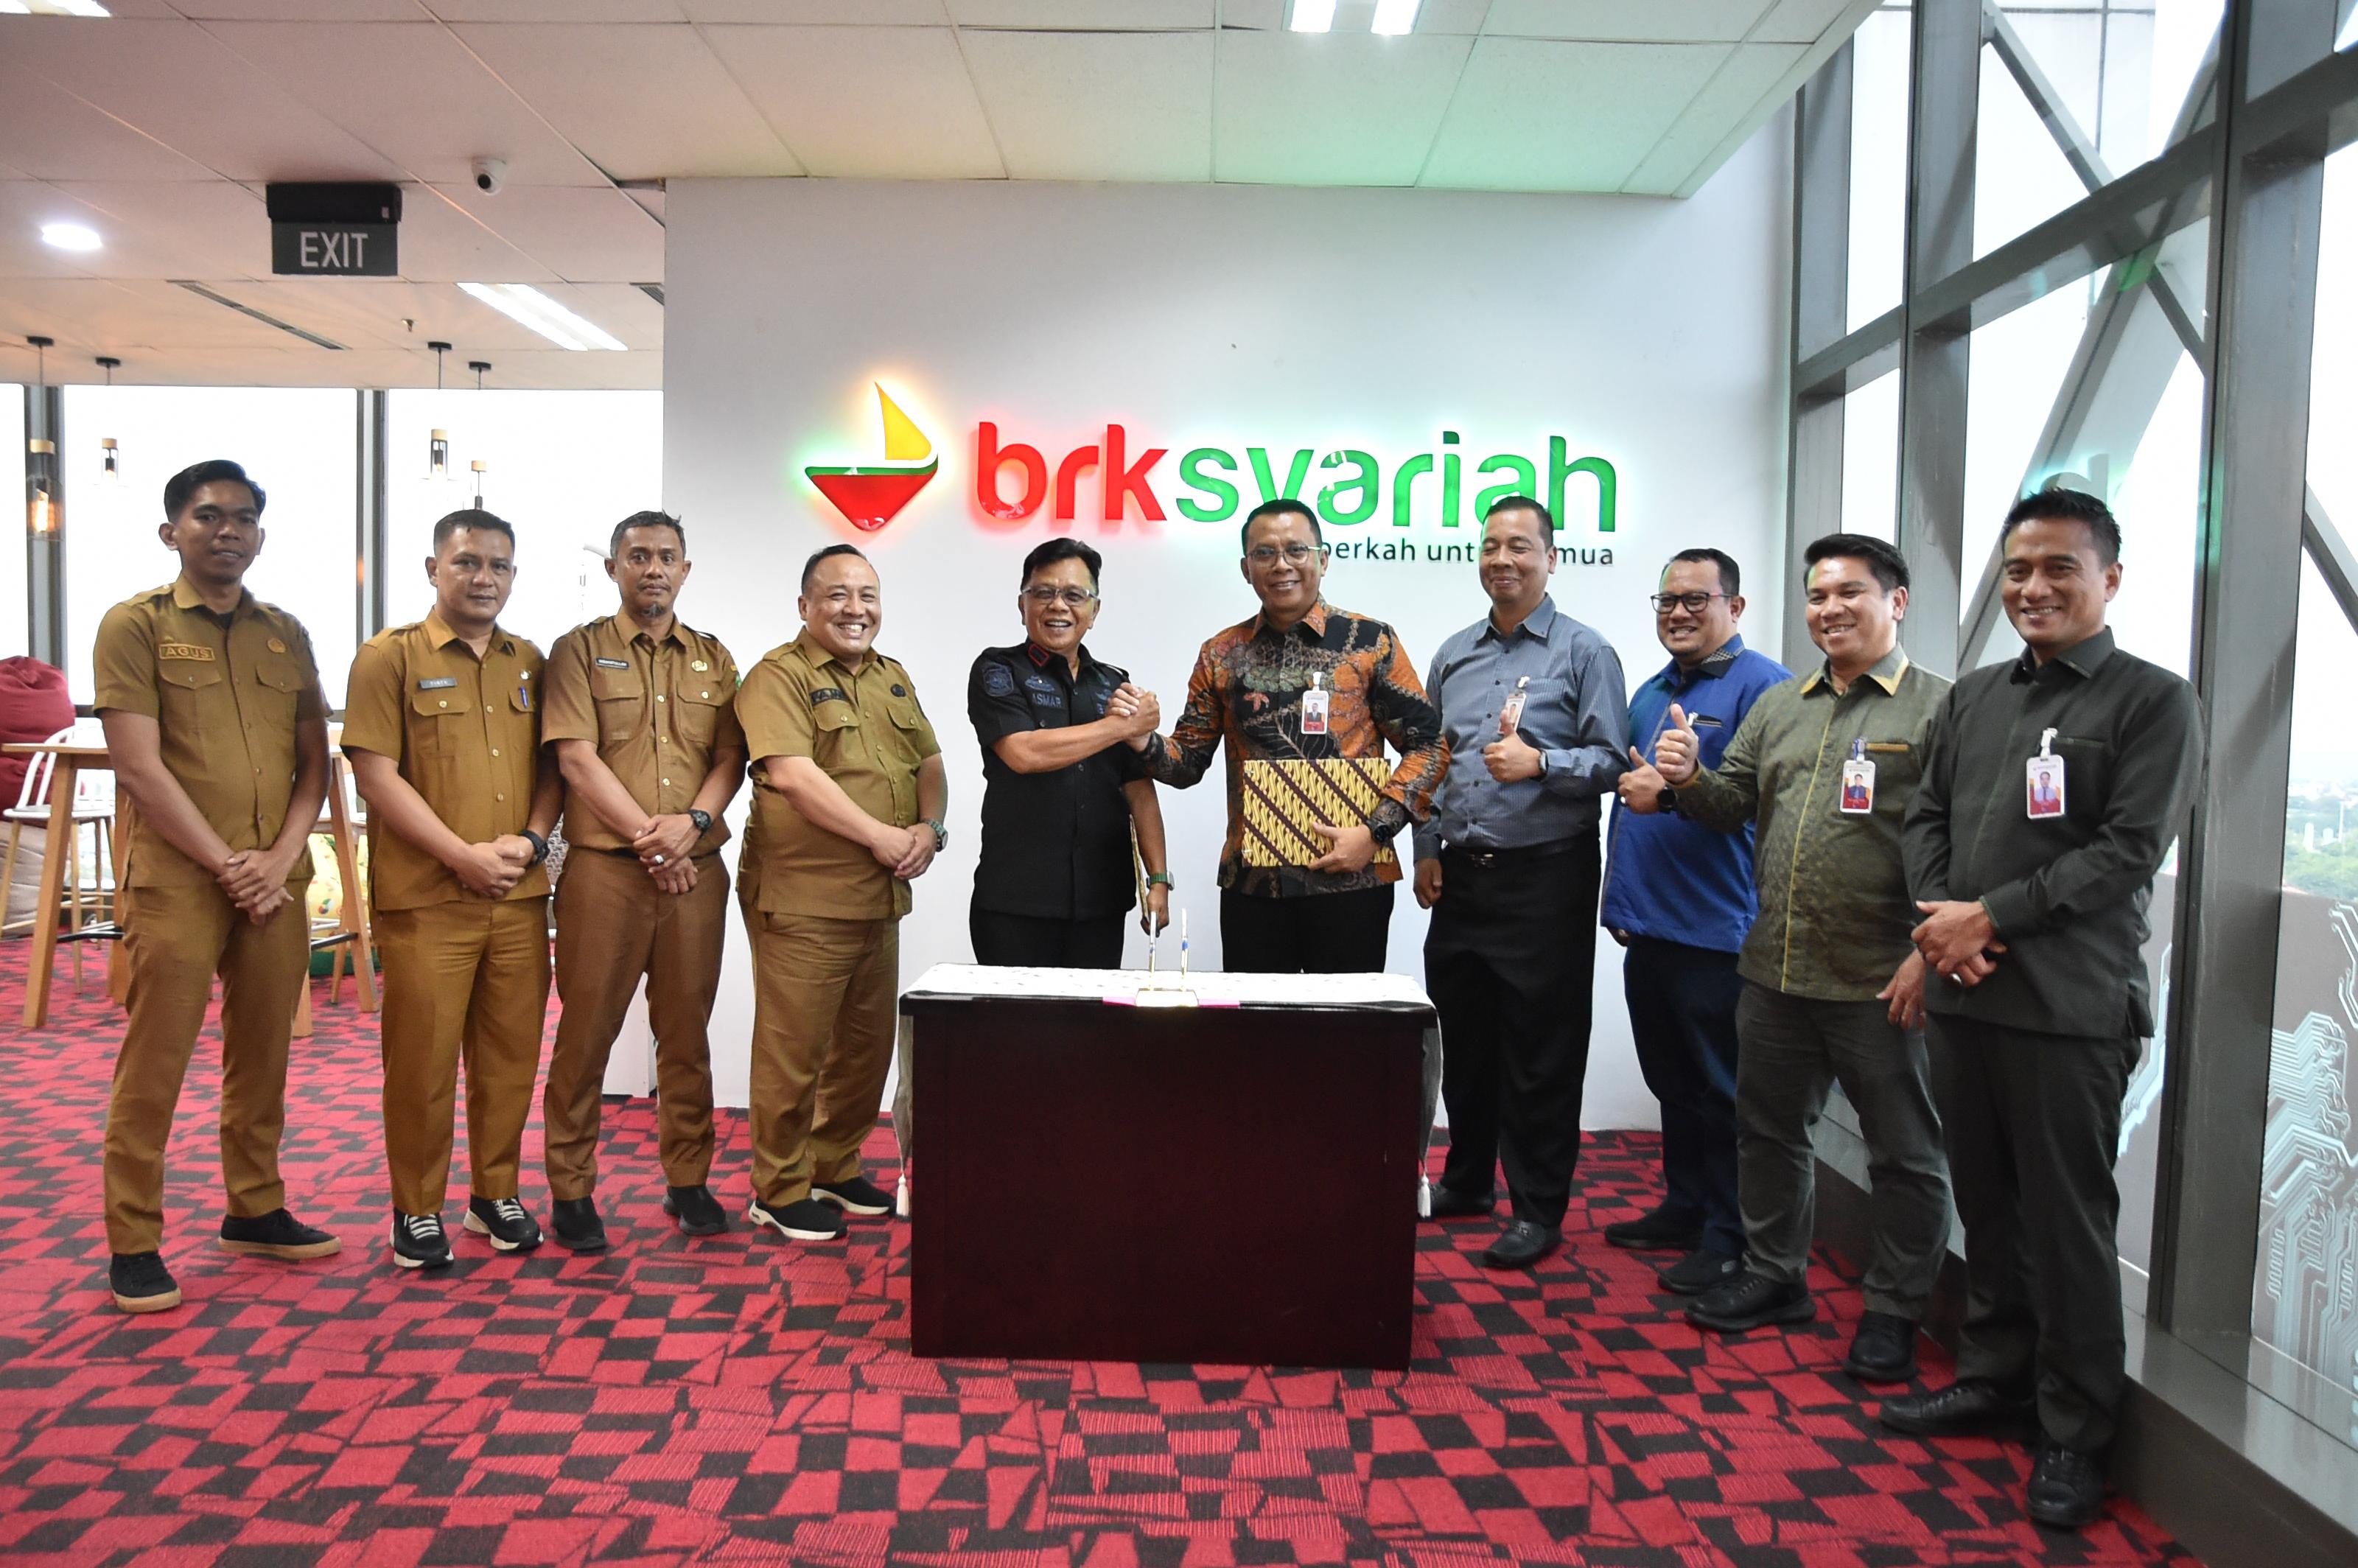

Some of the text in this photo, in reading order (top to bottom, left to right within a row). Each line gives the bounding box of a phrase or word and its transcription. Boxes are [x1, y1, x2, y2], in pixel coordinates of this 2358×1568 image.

[300, 231, 368, 268] EXIT
[1427, 542, 1475, 562] unt
[1557, 547, 1614, 565] mua
[165, 646, 209, 659] AGUS
